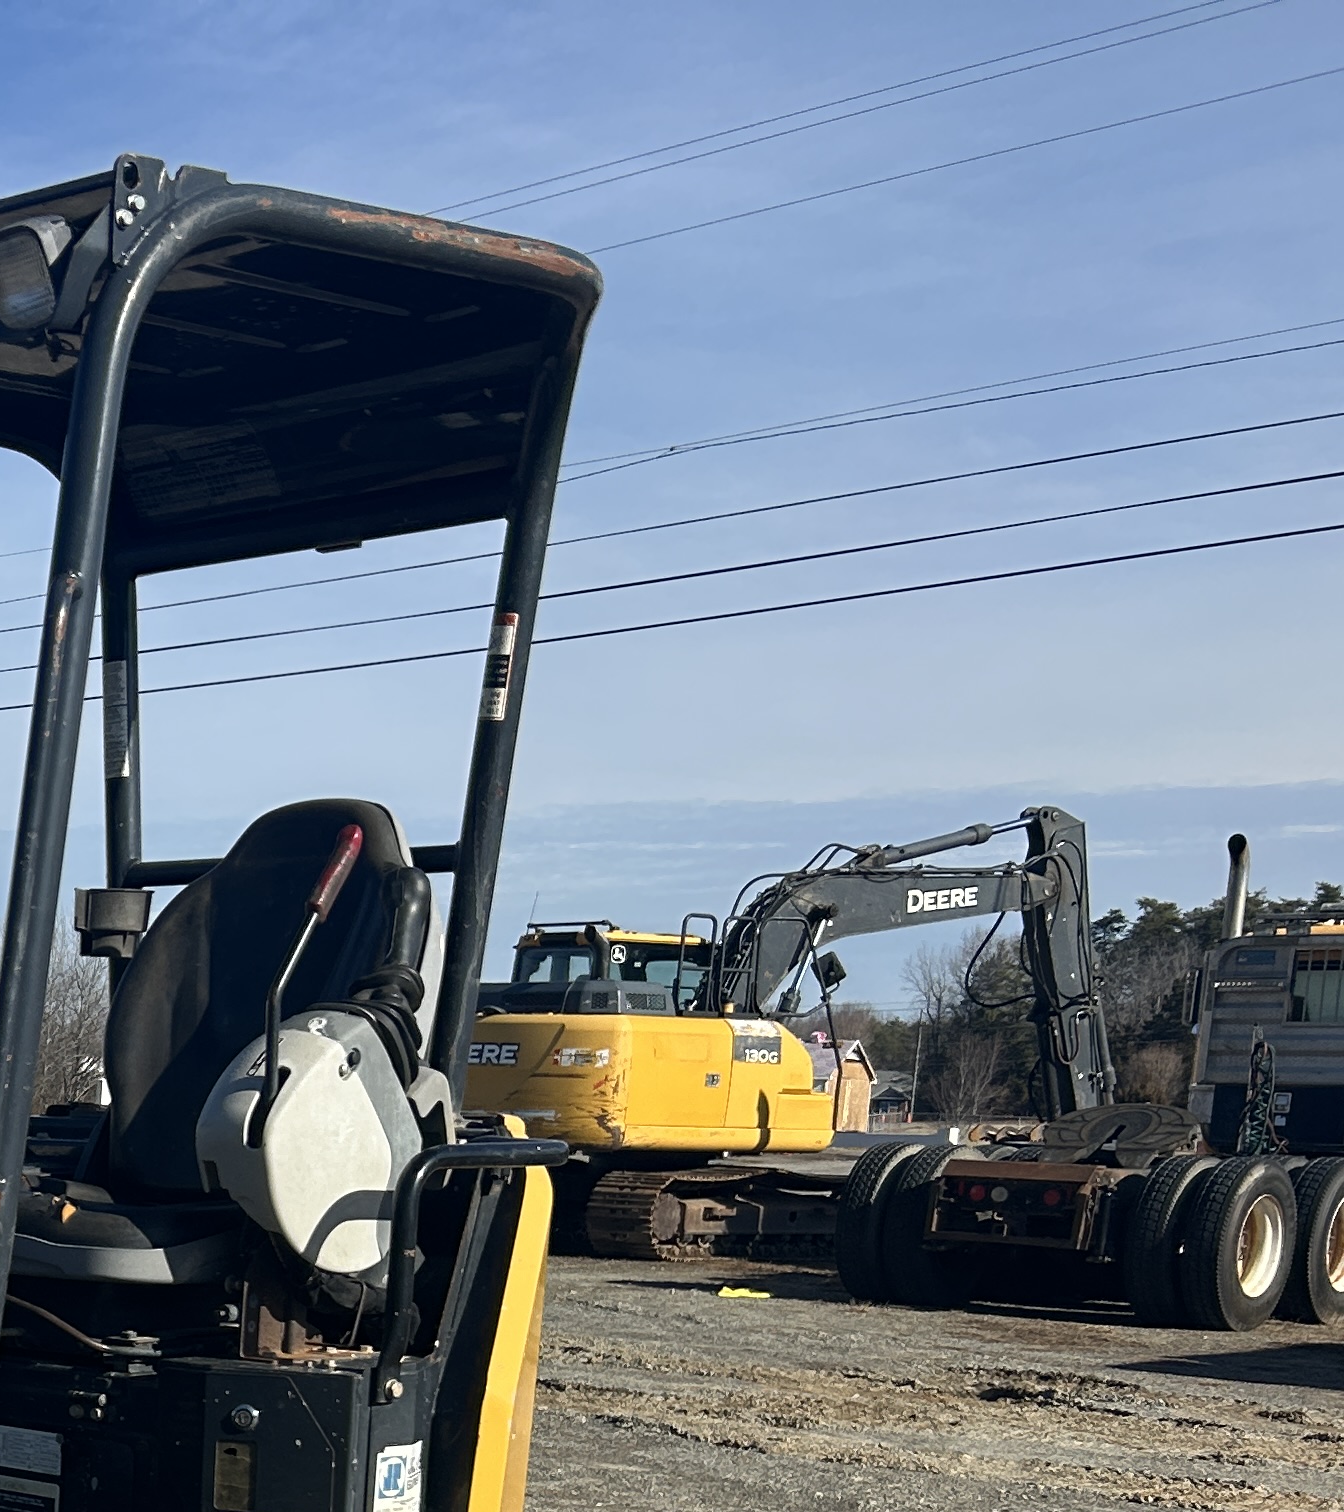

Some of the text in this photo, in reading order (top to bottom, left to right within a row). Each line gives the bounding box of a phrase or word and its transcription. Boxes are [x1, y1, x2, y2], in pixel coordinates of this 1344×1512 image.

[906, 886, 979, 914] DEERE
[467, 1043, 519, 1065] ERE
[744, 1048, 779, 1064] 130G
